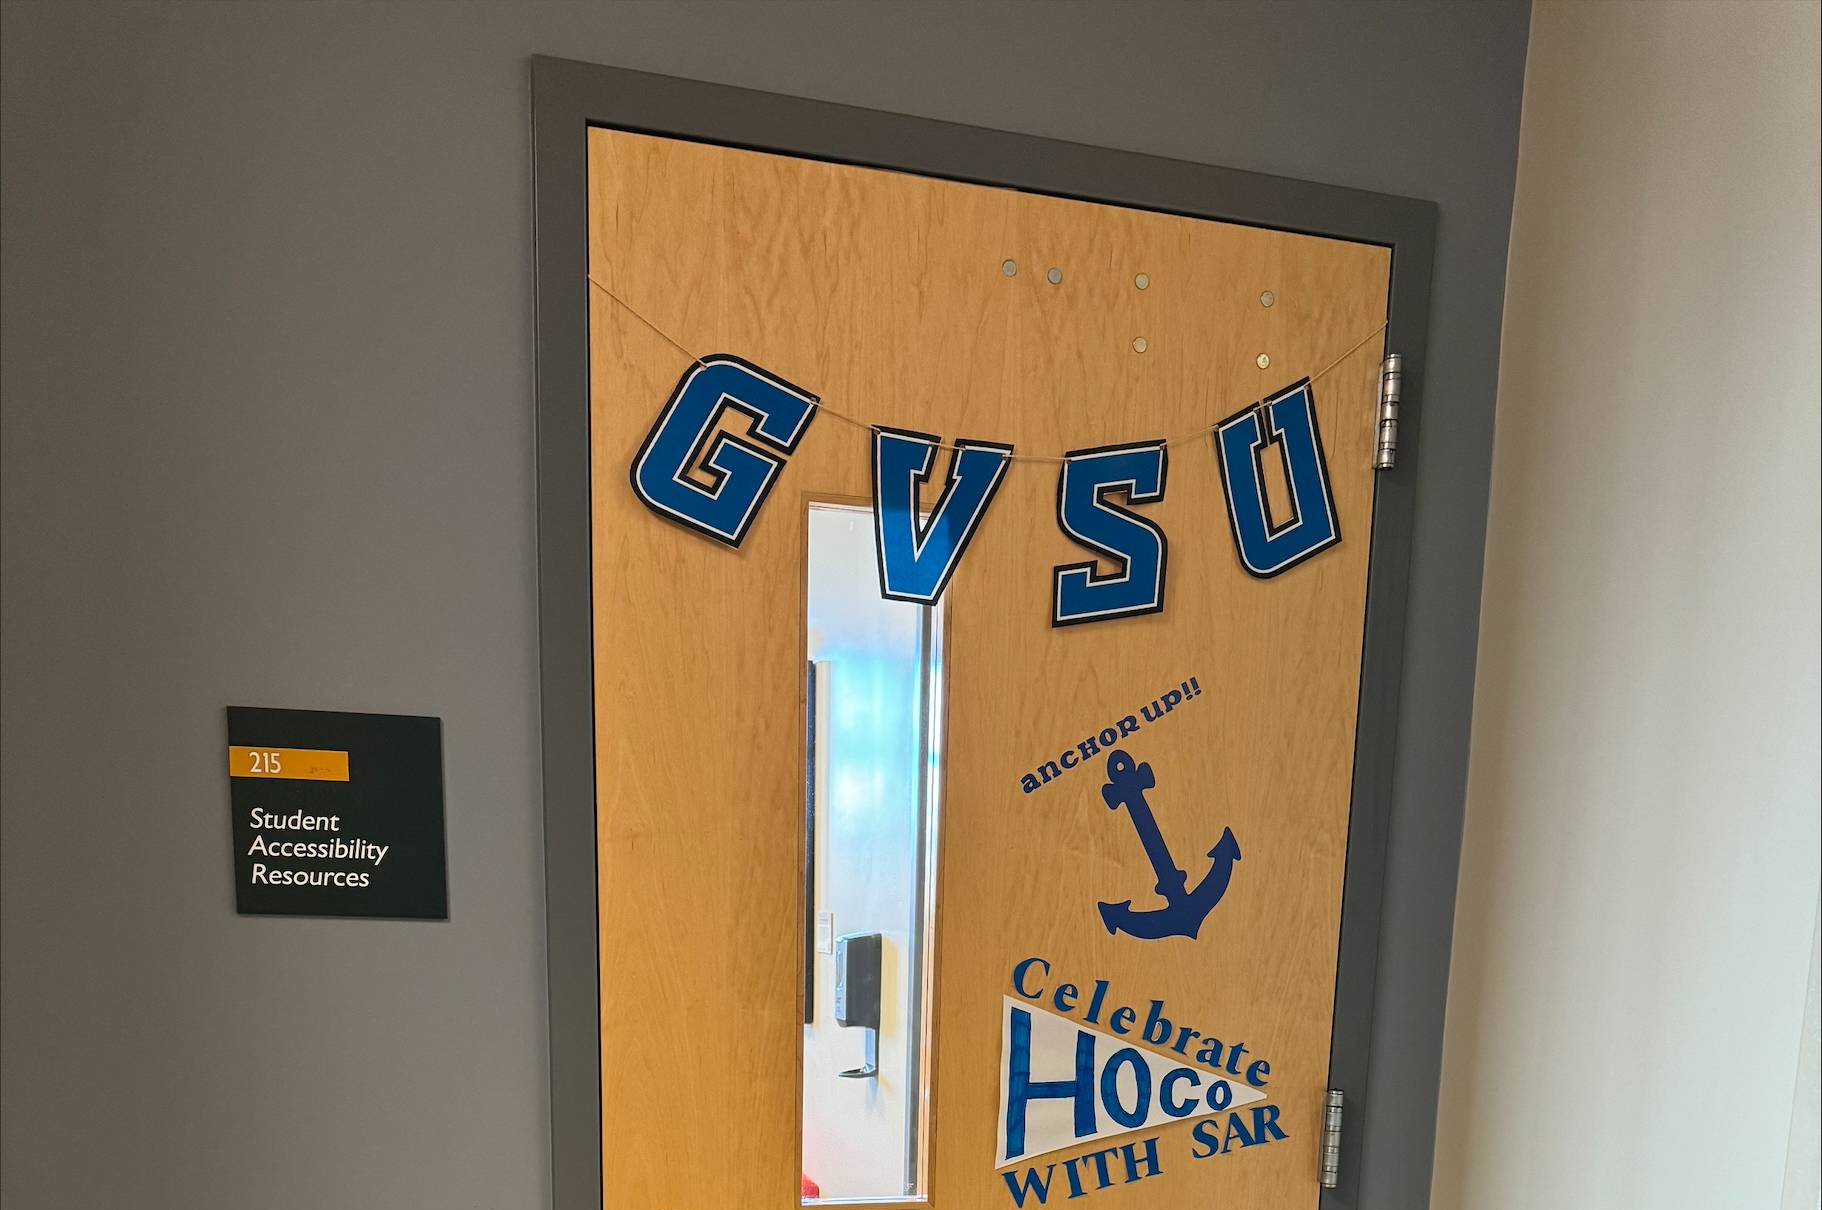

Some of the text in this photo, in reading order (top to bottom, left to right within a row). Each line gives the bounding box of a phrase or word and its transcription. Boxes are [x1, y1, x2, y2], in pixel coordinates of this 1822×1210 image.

[630, 353, 1342, 628] GVSU
[1140, 677, 1202, 722] up!!
[249, 751, 281, 773] 215
[250, 807, 340, 831] Student
[248, 835, 389, 865] Accessibility
[251, 863, 370, 887] Resources
[1012, 957, 1271, 1087] Celebrate
[1001, 1104, 1290, 1208] WITH SAR
